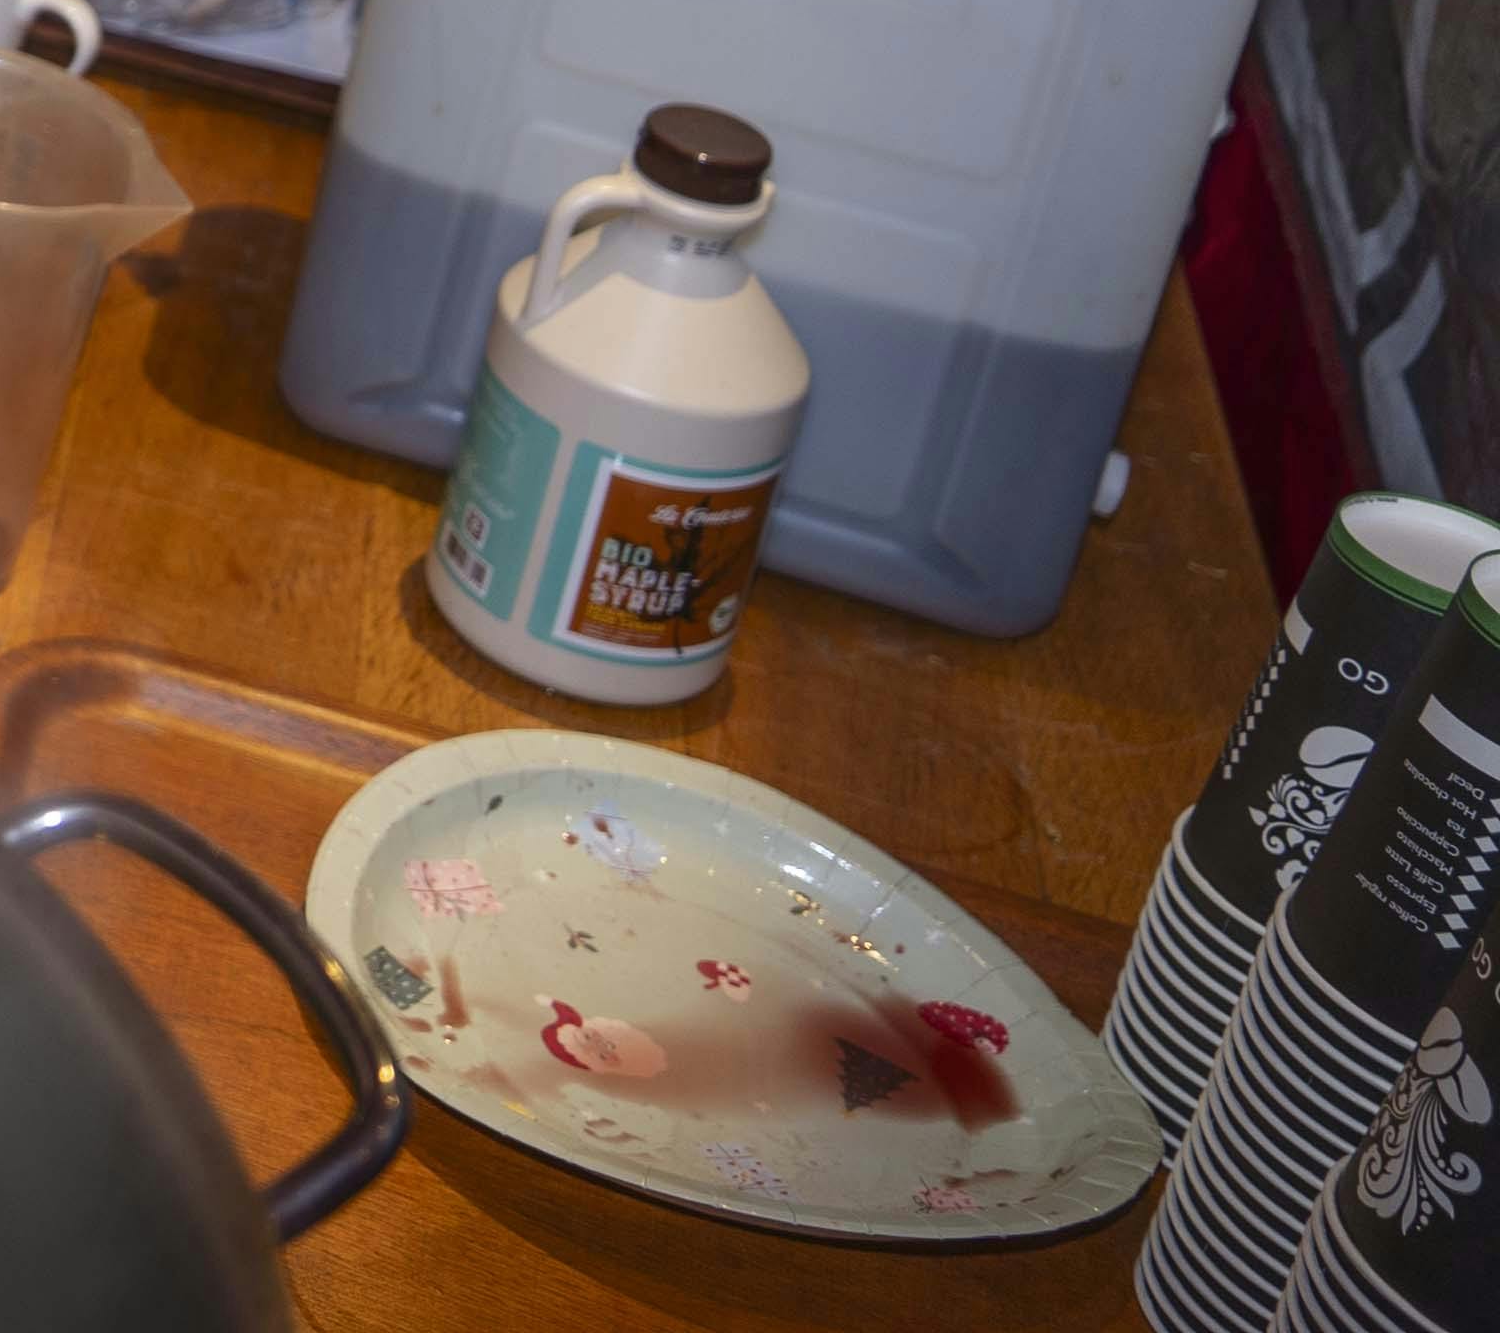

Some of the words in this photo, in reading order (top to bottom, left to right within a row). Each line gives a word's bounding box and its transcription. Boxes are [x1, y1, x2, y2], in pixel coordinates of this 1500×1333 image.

[602, 538, 653, 567] BIO
[595, 560, 701, 592] MAPLE-
[589, 581, 687, 616] SYRUP
[1338, 657, 1390, 695] GO
[1403, 758, 1450, 801] chocolate
[1447, 772, 1485, 801] Decaf
[1451, 797, 1477, 821] Hot
[1396, 806, 1460, 857] Cappuccino
[1446, 818, 1467, 839] Tea
[1384, 845, 1411, 872] Latte
[1396, 831, 1453, 876] Macchiato
[1355, 872, 1388, 903] regular
[1386, 874, 1437, 915] Espresso
[1388, 899, 1428, 932] Coffee
[1472, 937, 1492, 979] GO
